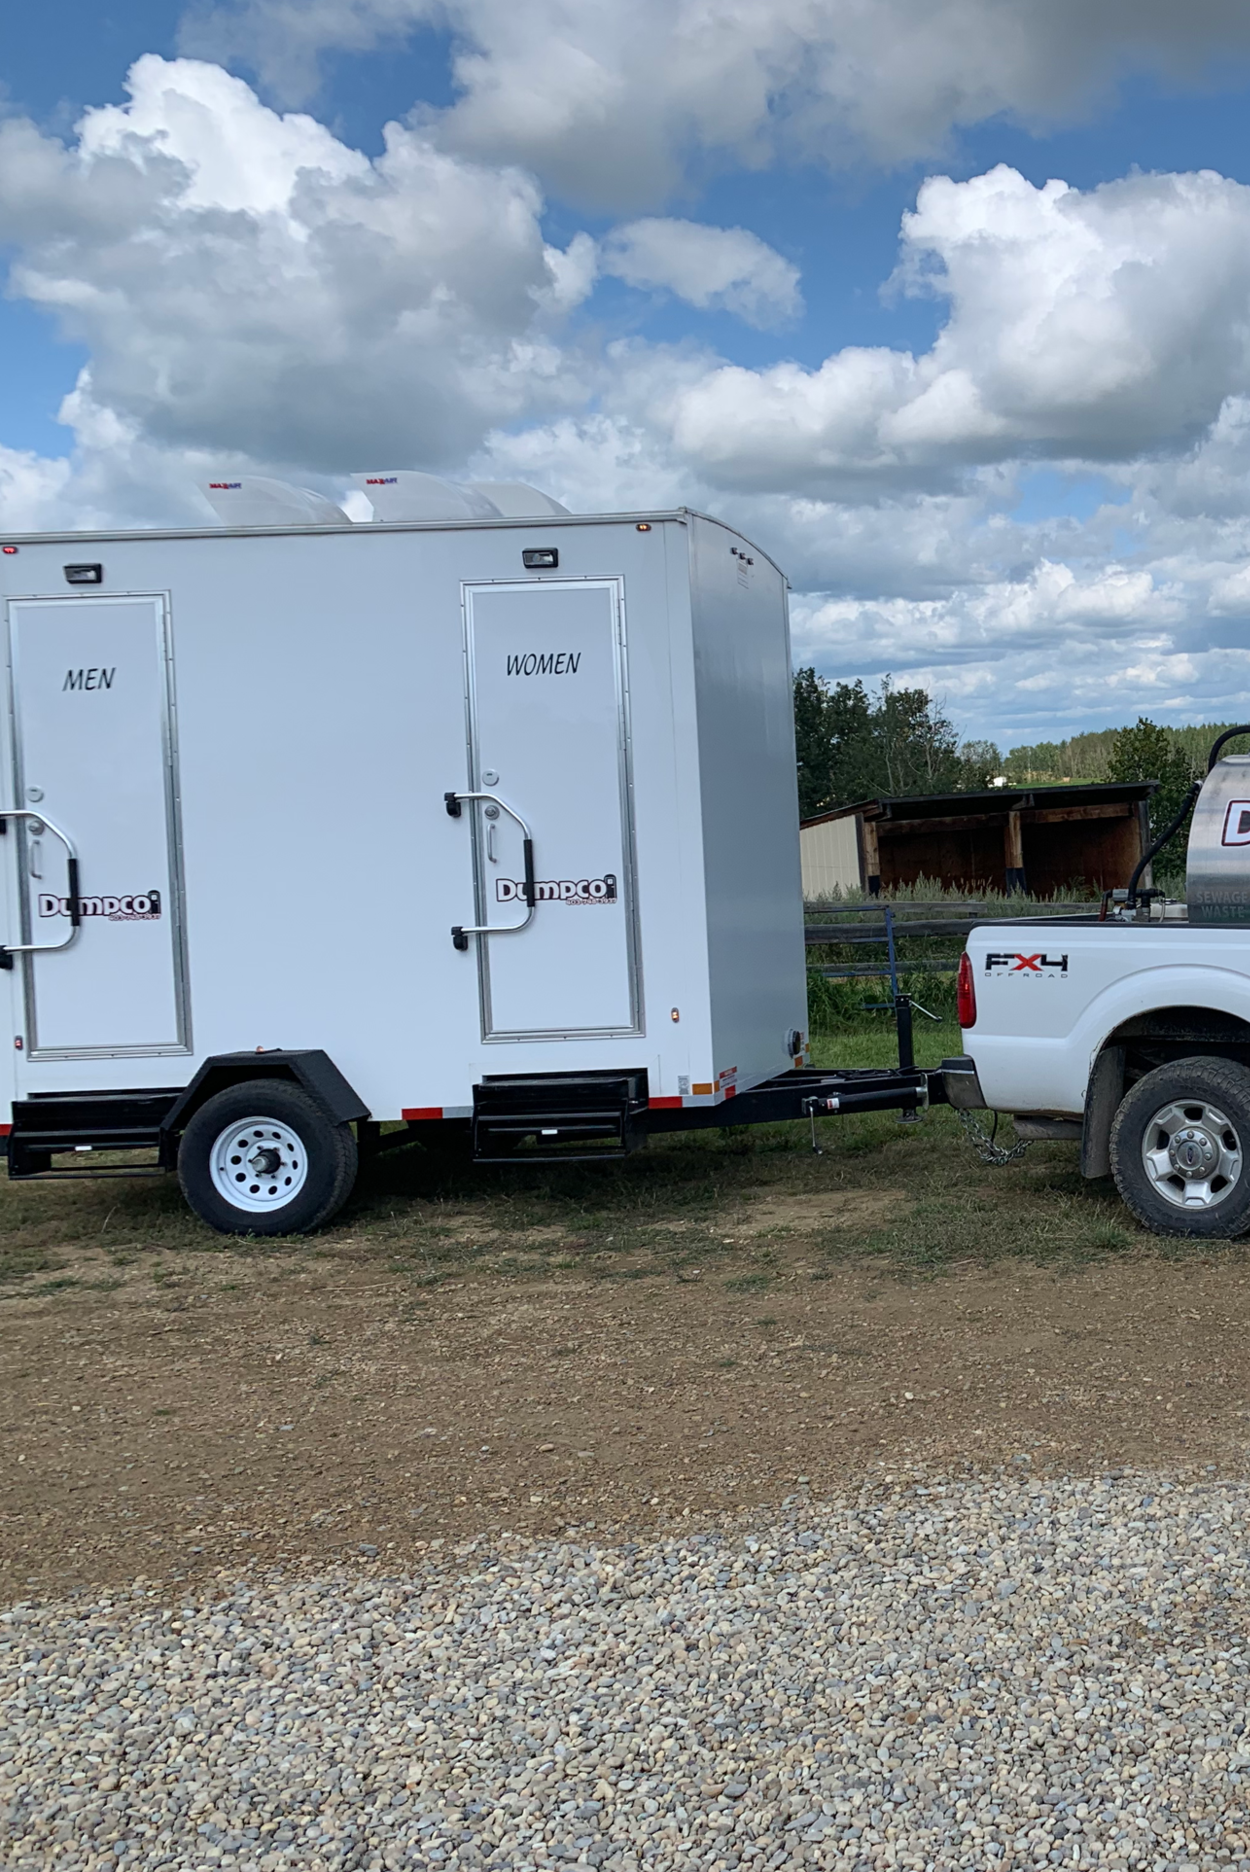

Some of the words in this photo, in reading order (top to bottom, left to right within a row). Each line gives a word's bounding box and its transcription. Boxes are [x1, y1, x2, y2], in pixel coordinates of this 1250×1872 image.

[506, 652, 582, 676] WOMEN
[62, 667, 116, 691] MEN
[1196, 891, 1248, 903] SEWAGE
[1201, 905, 1245, 918] WASTE
[985, 953, 1068, 971] FX4
